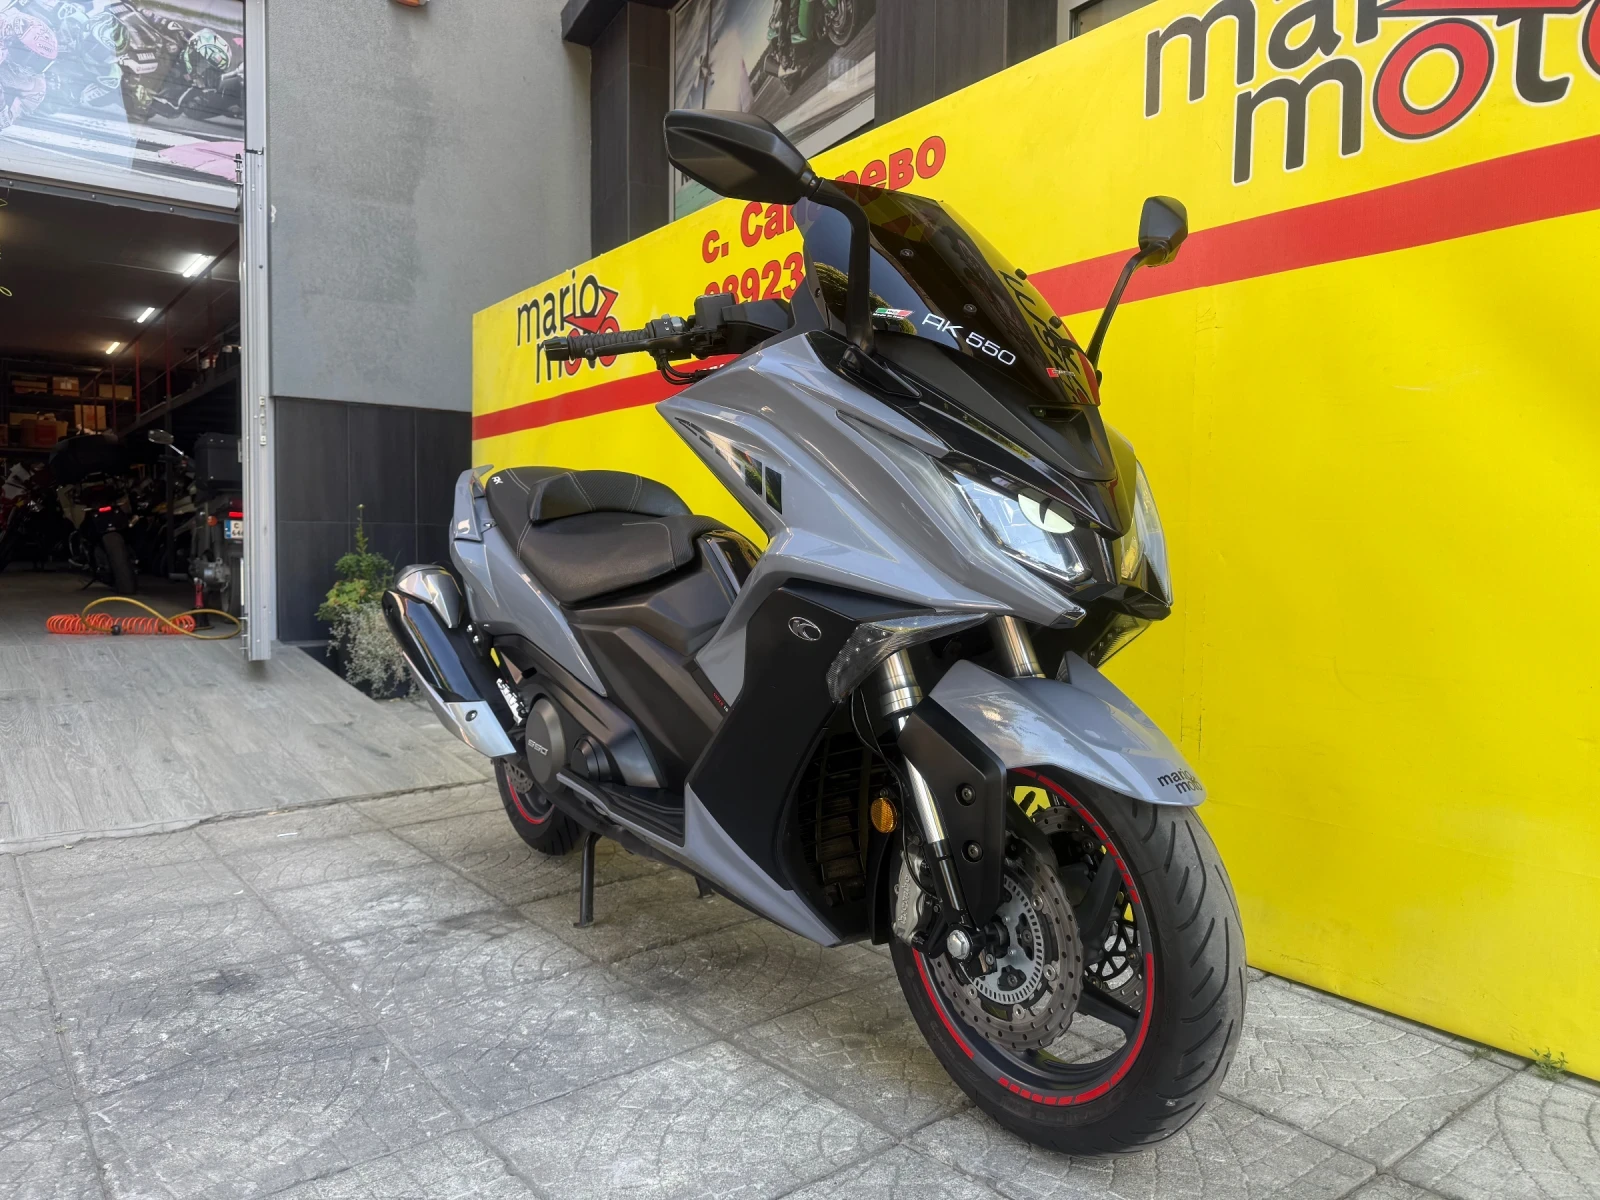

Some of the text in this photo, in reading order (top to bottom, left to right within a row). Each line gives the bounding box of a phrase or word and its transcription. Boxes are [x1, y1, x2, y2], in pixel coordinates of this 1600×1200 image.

[1233, 14, 1600, 184] mot
[517, 269, 600, 346] mario
[922, 313, 963, 338] AK
[965, 332, 1016, 366] 550
[527, 739, 549, 756] 550
[1157, 768, 1195, 787] mario
